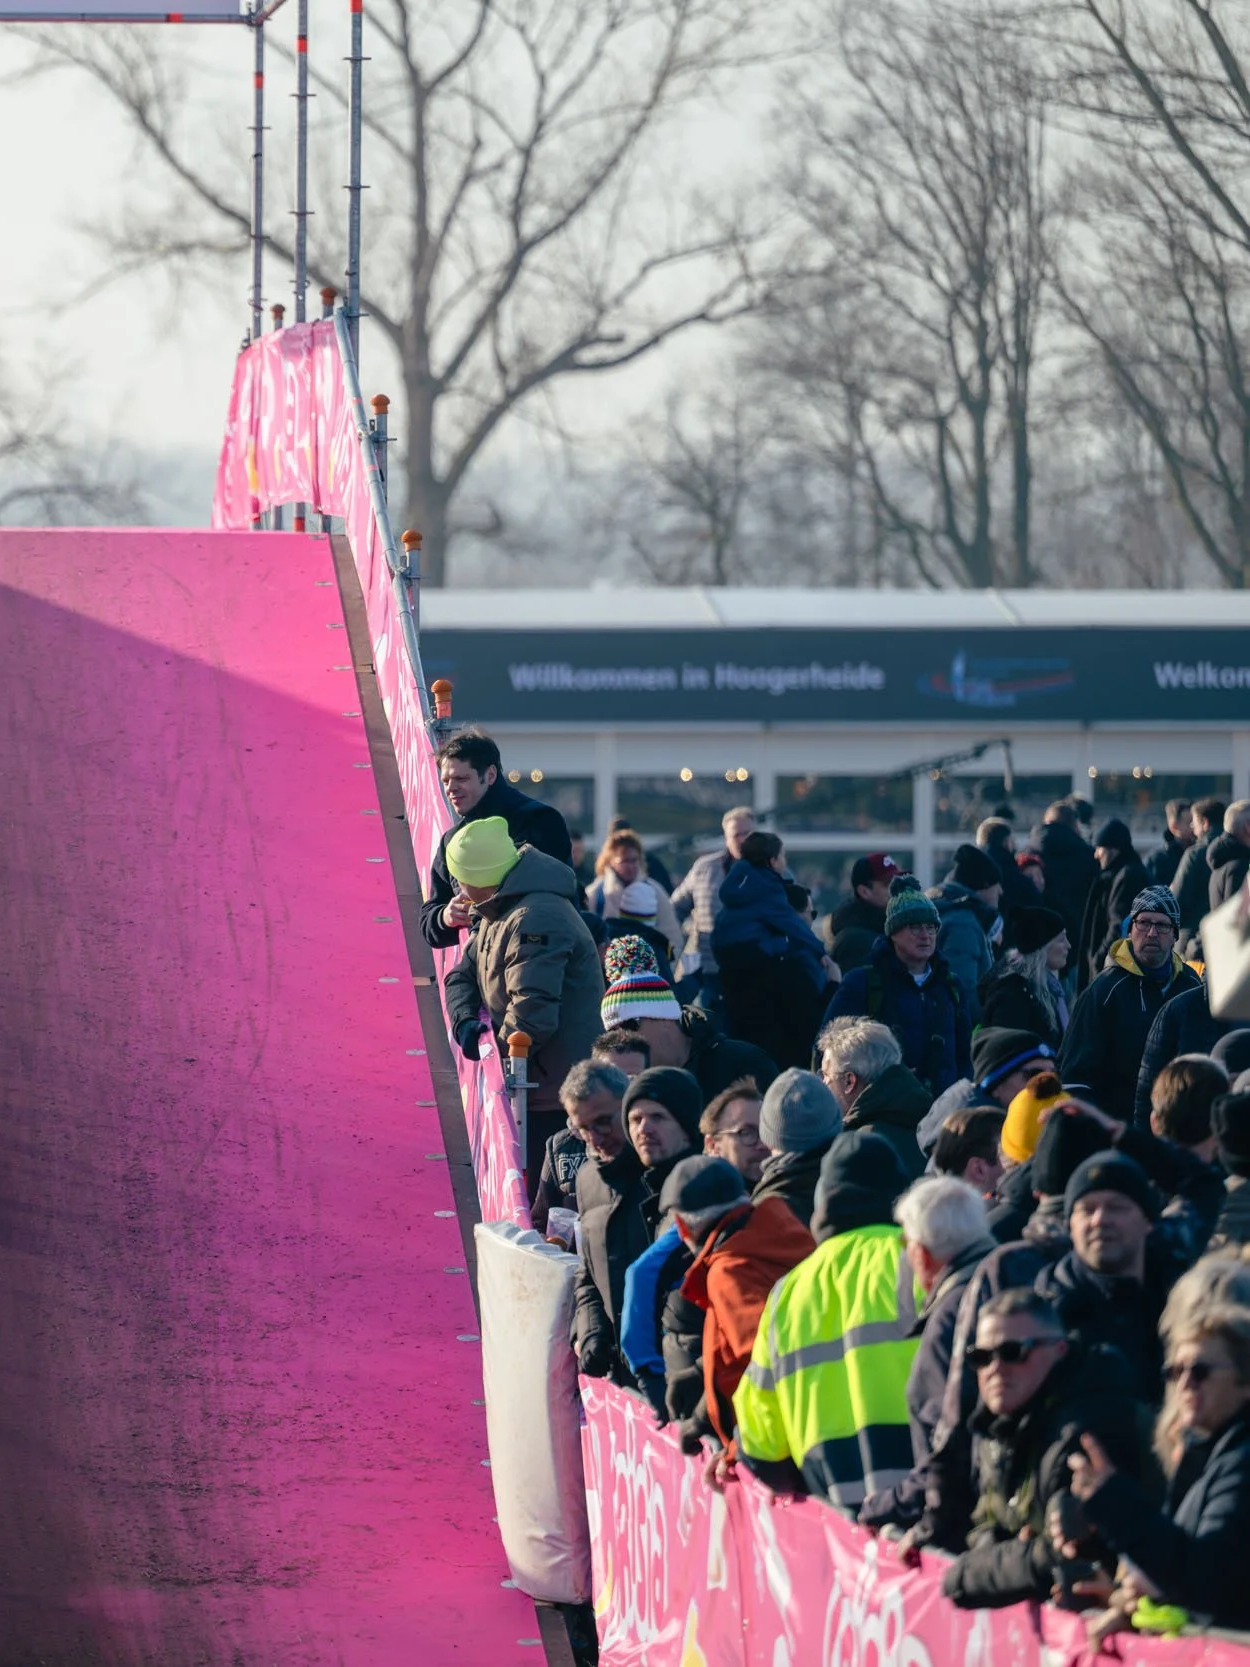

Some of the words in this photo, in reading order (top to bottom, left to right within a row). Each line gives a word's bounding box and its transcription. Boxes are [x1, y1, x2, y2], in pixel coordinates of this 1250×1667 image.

[509, 662, 678, 692] Willkommen
[681, 662, 710, 691] in
[714, 661, 886, 696] Hoogerheide
[558, 1156, 588, 1180] FX
